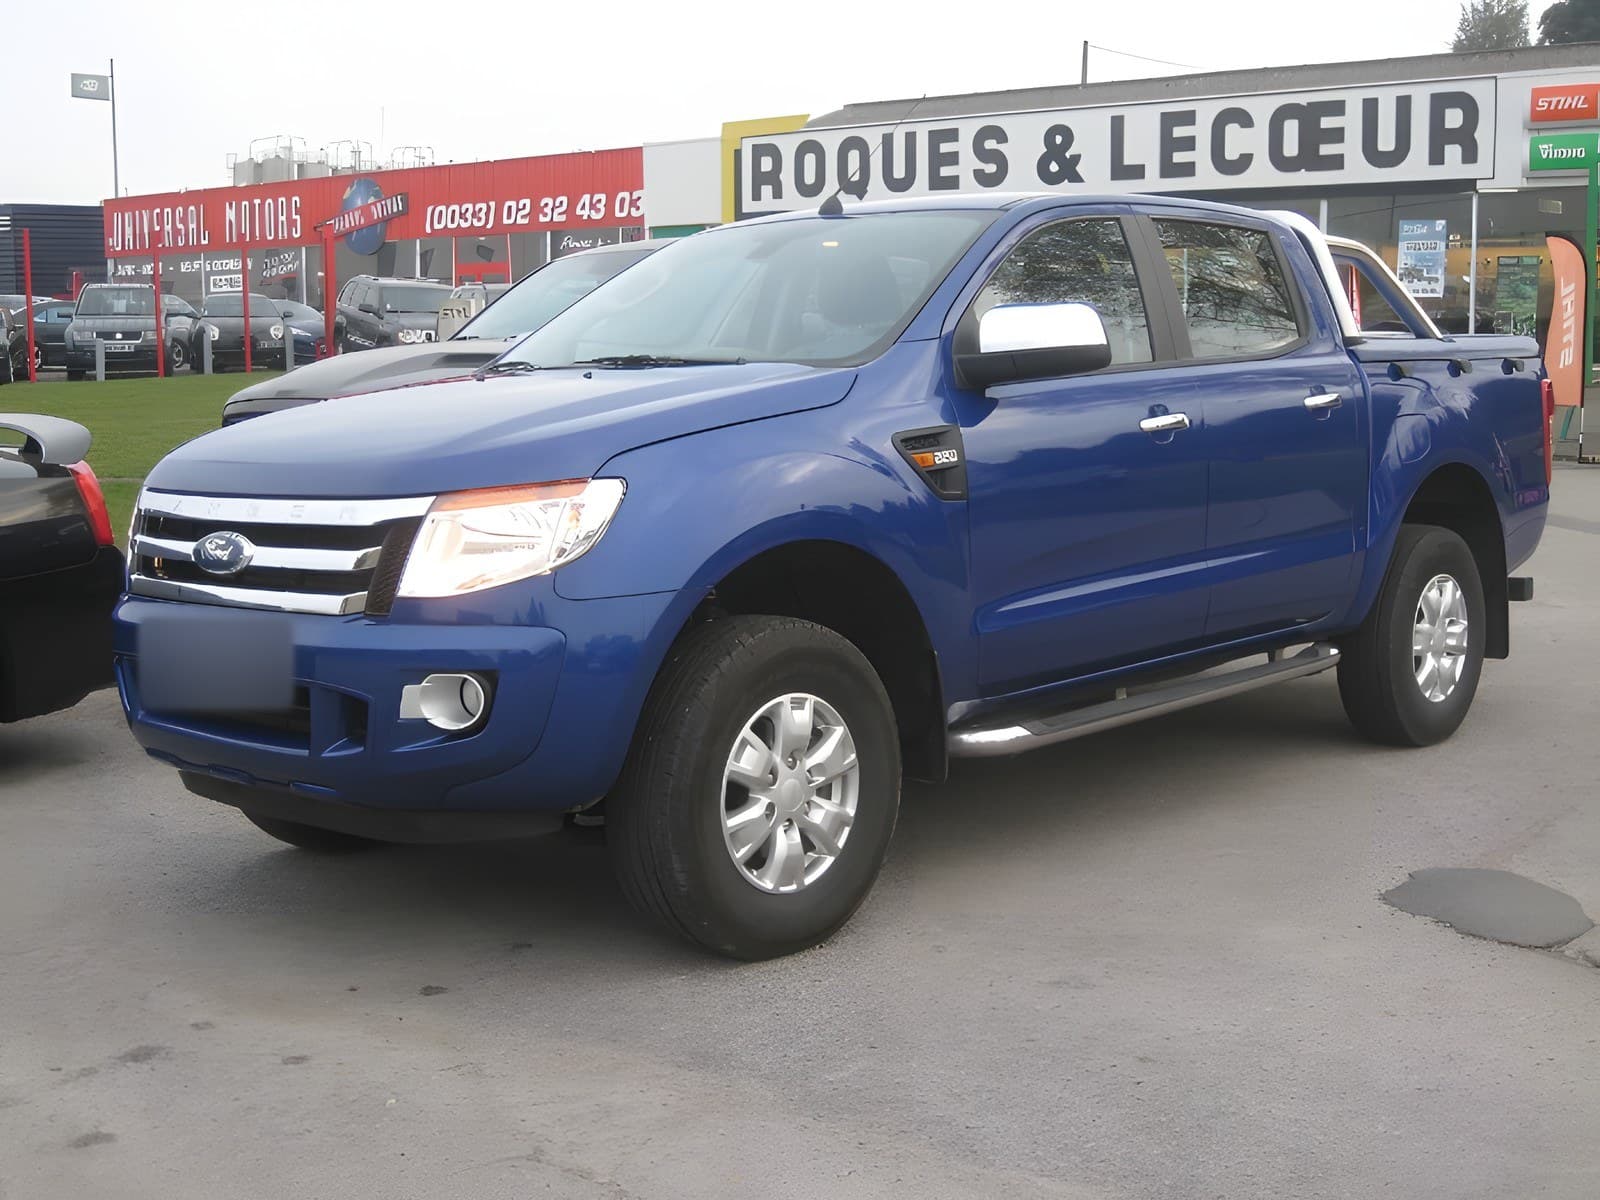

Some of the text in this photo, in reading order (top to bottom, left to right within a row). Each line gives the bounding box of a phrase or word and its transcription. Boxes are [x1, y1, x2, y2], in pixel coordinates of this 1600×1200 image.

[1535, 95, 1589, 111] STIHL
[751, 91, 1480, 202] ROQUES & LECŒUR
[224, 195, 302, 244] MOTORS
[425, 200, 496, 233] (0033)
[502, 198, 531, 225] 02
[538, 195, 568, 223] 32
[575, 193, 606, 220] 43
[614, 189, 645, 218] 03
